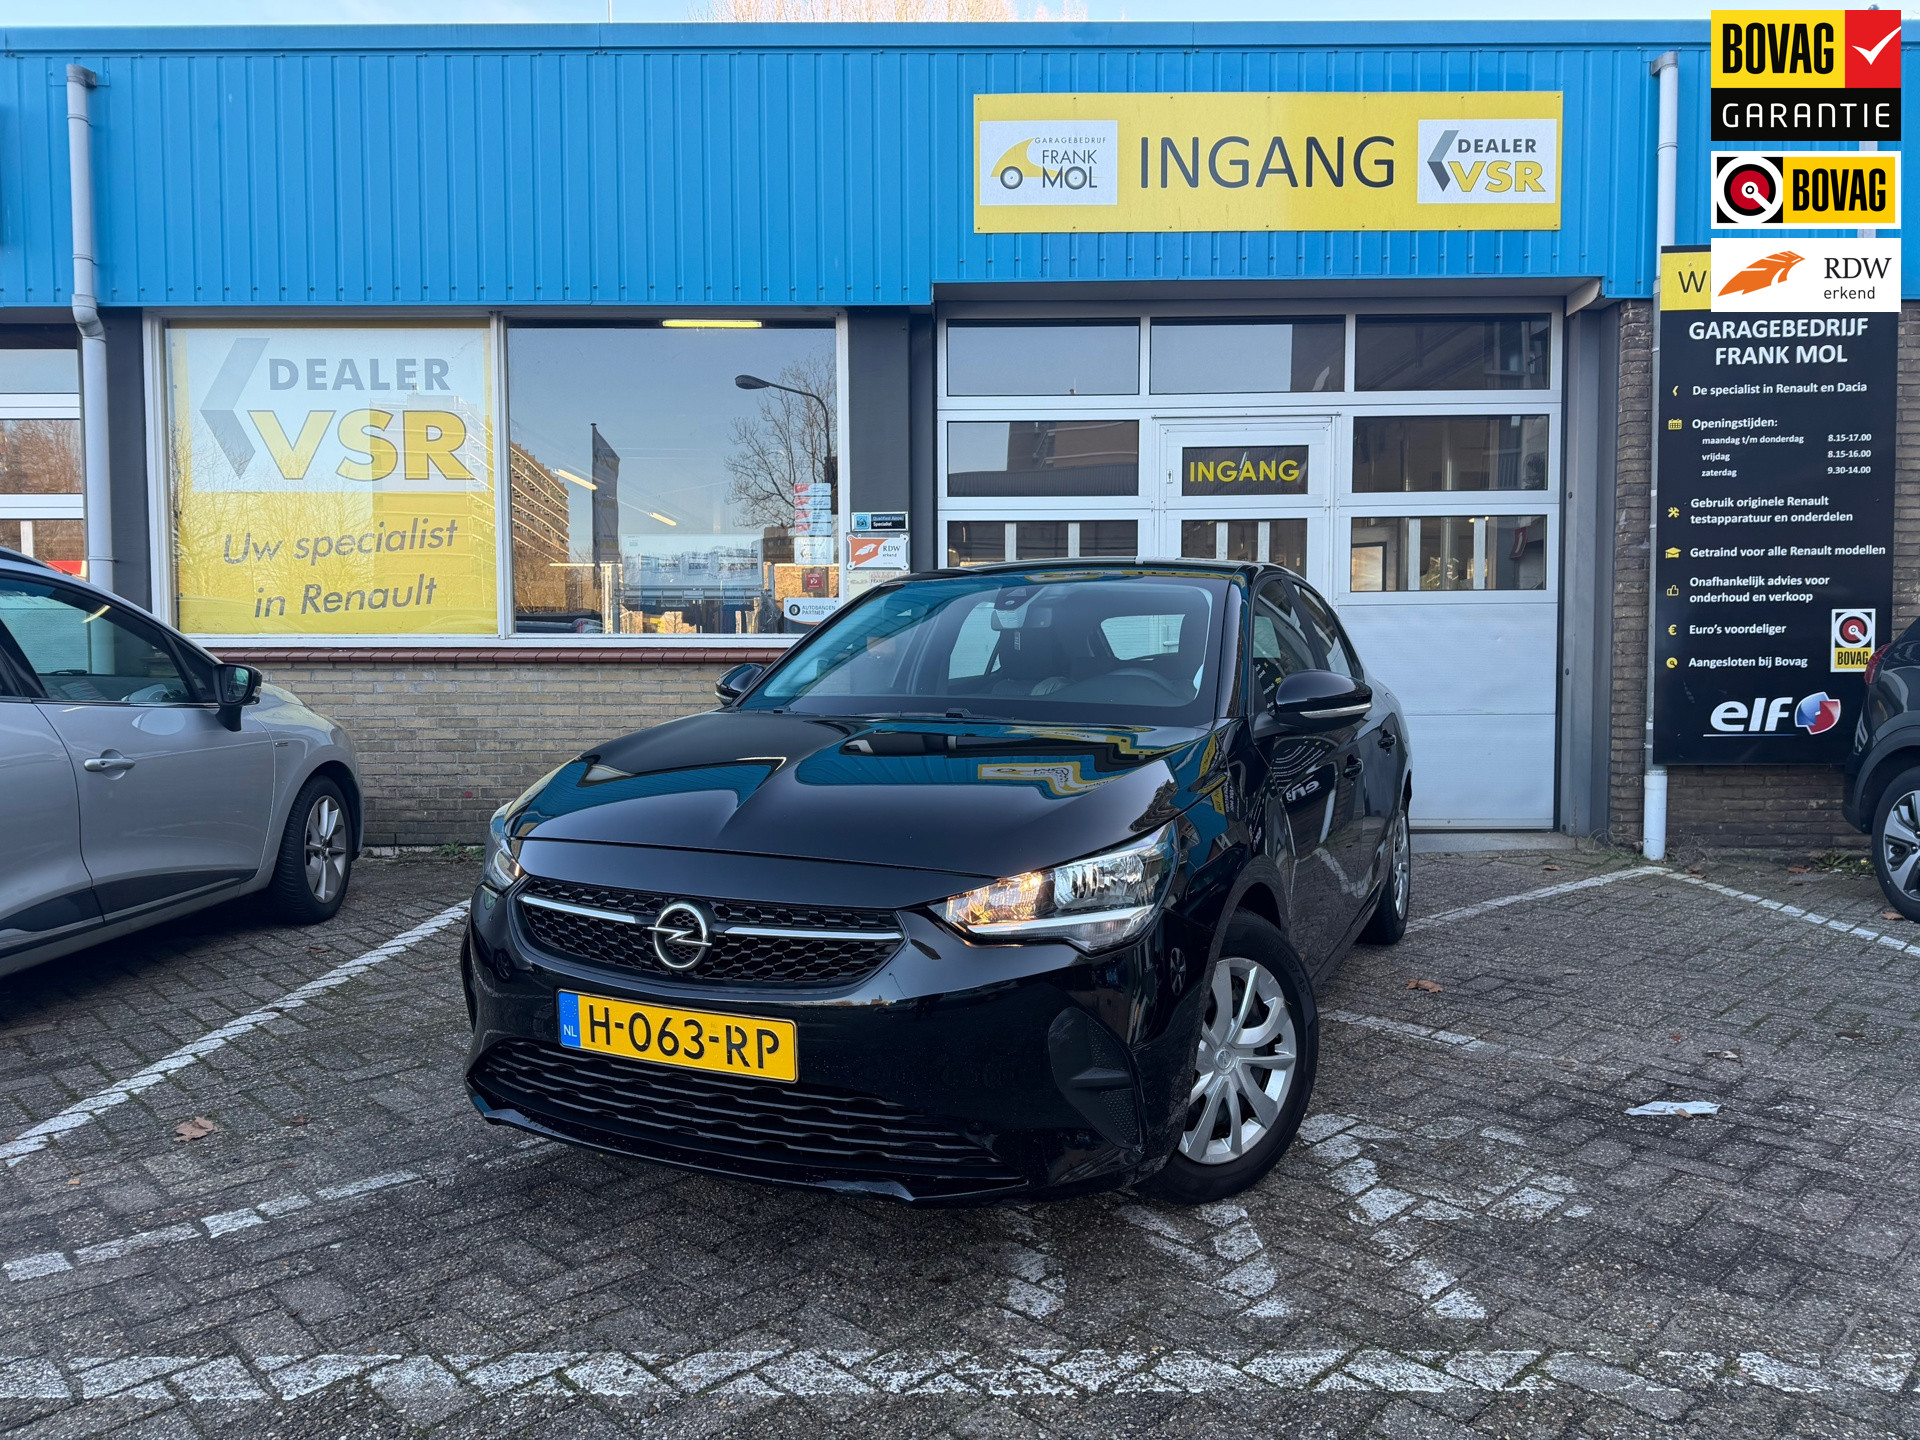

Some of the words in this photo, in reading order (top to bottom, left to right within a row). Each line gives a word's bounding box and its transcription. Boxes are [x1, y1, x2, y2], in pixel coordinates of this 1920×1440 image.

[1458, 139, 1537, 153] DEALER
[1042, 150, 1097, 164] FRANK
[1140, 136, 1395, 188] INGANG
[1042, 166, 1098, 189] MOL
[1448, 160, 1546, 192] VSR
[1689, 318, 1869, 340] GARAGEBEDRIJF
[1715, 346, 1790, 366] FRANK
[1796, 344, 1848, 364] MOL
[269, 358, 450, 390] DEALER
[1693, 386, 1708, 395] De
[1711, 384, 1761, 397] specialist
[1763, 383, 1774, 393] in
[1776, 382, 1819, 394] Renault
[1821, 384, 1835, 393] en
[1837, 382, 1868, 392] Dacia
[1692, 418, 1778, 430] Openingstijden:
[247, 408, 477, 481] VSR
[1702, 436, 1741, 446] maandag
[1742, 434, 1758, 445] t/m
[1759, 434, 1805, 445] donderdag
[1827, 433, 1872, 443] 8.15-17.00
[1701, 452, 1731, 463] vrijdag
[1827, 450, 1872, 459] 8.15-16.00
[1189, 460, 1300, 483] INGANG
[1701, 468, 1738, 479] zaterdag
[1827, 466, 1872, 475] 9.30-14.00
[1690, 497, 1735, 508] Gebruik
[1736, 497, 1785, 508] originele
[1787, 495, 1830, 507] Renault
[1690, 513, 1772, 525] testapparatuur
[1774, 514, 1788, 522] en
[1790, 511, 1854, 523] onderdelen
[223, 532, 283, 565] Uw
[293, 517, 459, 567] specialist
[1690, 546, 1738, 558] Getraind
[1740, 548, 1766, 557] voor
[1768, 546, 1789, 556] alle
[1790, 545, 1833, 556] Renault
[1834, 545, 1886, 556] modellen
[1689, 576, 1766, 588] Onafhankelijk
[1767, 576, 1803, 586] advies
[1804, 577, 1830, 586] voor
[255, 587, 286, 618] in
[300, 573, 438, 615] Renault
[1689, 592, 1750, 603] onderhoud
[1752, 594, 1766, 602] en
[1768, 591, 1814, 604] verkoop
[1724, 623, 1787, 636] voordeliger
[1688, 656, 1756, 668] Aangesloten
[1758, 655, 1772, 669] bij
[1774, 655, 1808, 668] Bovag
[1837, 650, 1869, 666] BOVAG
[1710, 696, 1794, 732] elf
[563, 1024, 577, 1038] NL
[588, 1004, 780, 1069] H-063-RP
